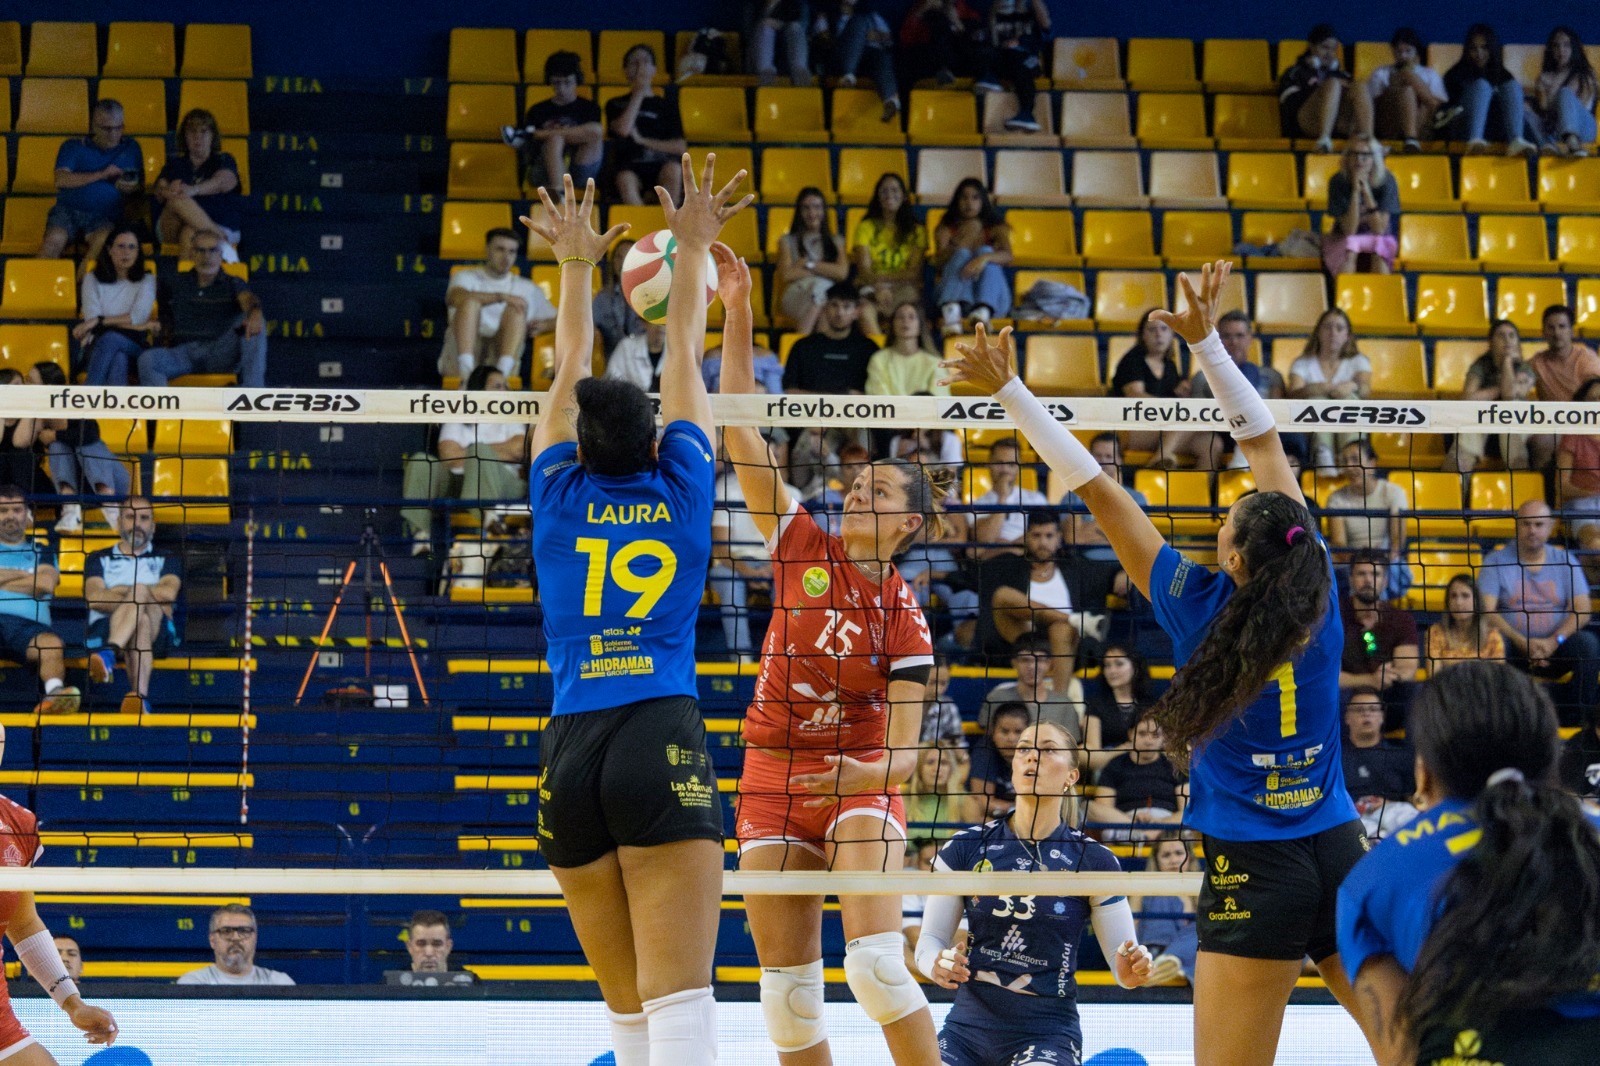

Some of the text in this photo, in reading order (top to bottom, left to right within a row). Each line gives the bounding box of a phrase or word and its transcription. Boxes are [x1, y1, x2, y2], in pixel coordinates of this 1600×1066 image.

[265, 76, 322, 93] FILA
[264, 193, 323, 211] FILA
[250, 254, 310, 272] FILA
[50, 388, 181, 410] rfevb.com
[409, 393, 540, 415] rfevb.com
[766, 397, 896, 419] rfevb.com
[1122, 401, 1225, 422] rfevb.co
[586, 502, 672, 525] LAURA
[575, 537, 677, 619] 19
[814, 609, 863, 660] 15
[591, 655, 654, 672] HIDRAMAR
[606, 669, 629, 677] GROUP
[670, 781, 713, 793] Las Palmas
[1208, 911, 1251, 921] GranCanaria
[1011, 951, 1049, 967] Menorca
